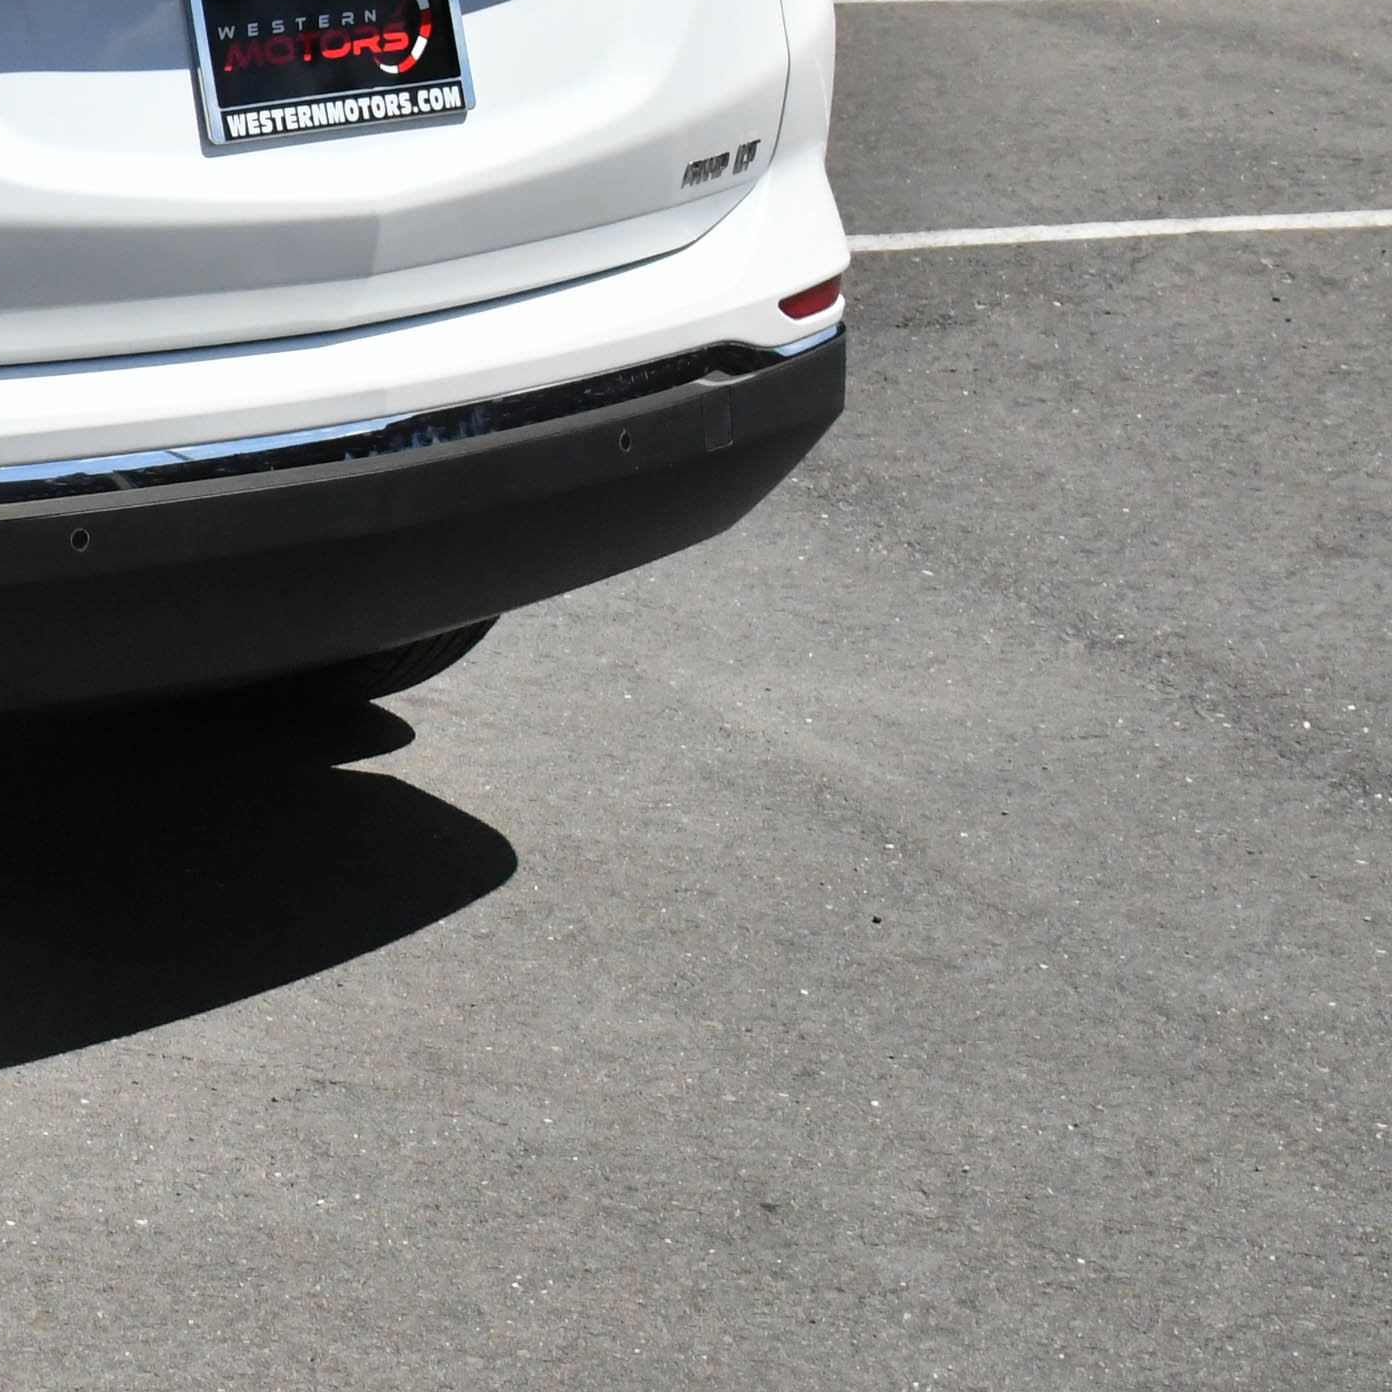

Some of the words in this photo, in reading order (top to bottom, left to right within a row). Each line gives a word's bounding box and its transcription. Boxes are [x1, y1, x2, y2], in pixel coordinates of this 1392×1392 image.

[218, 9, 377, 40] WESTERN
[224, 24, 410, 72] MOTORS
[226, 86, 462, 138] WESTERNMOTORS.COM
